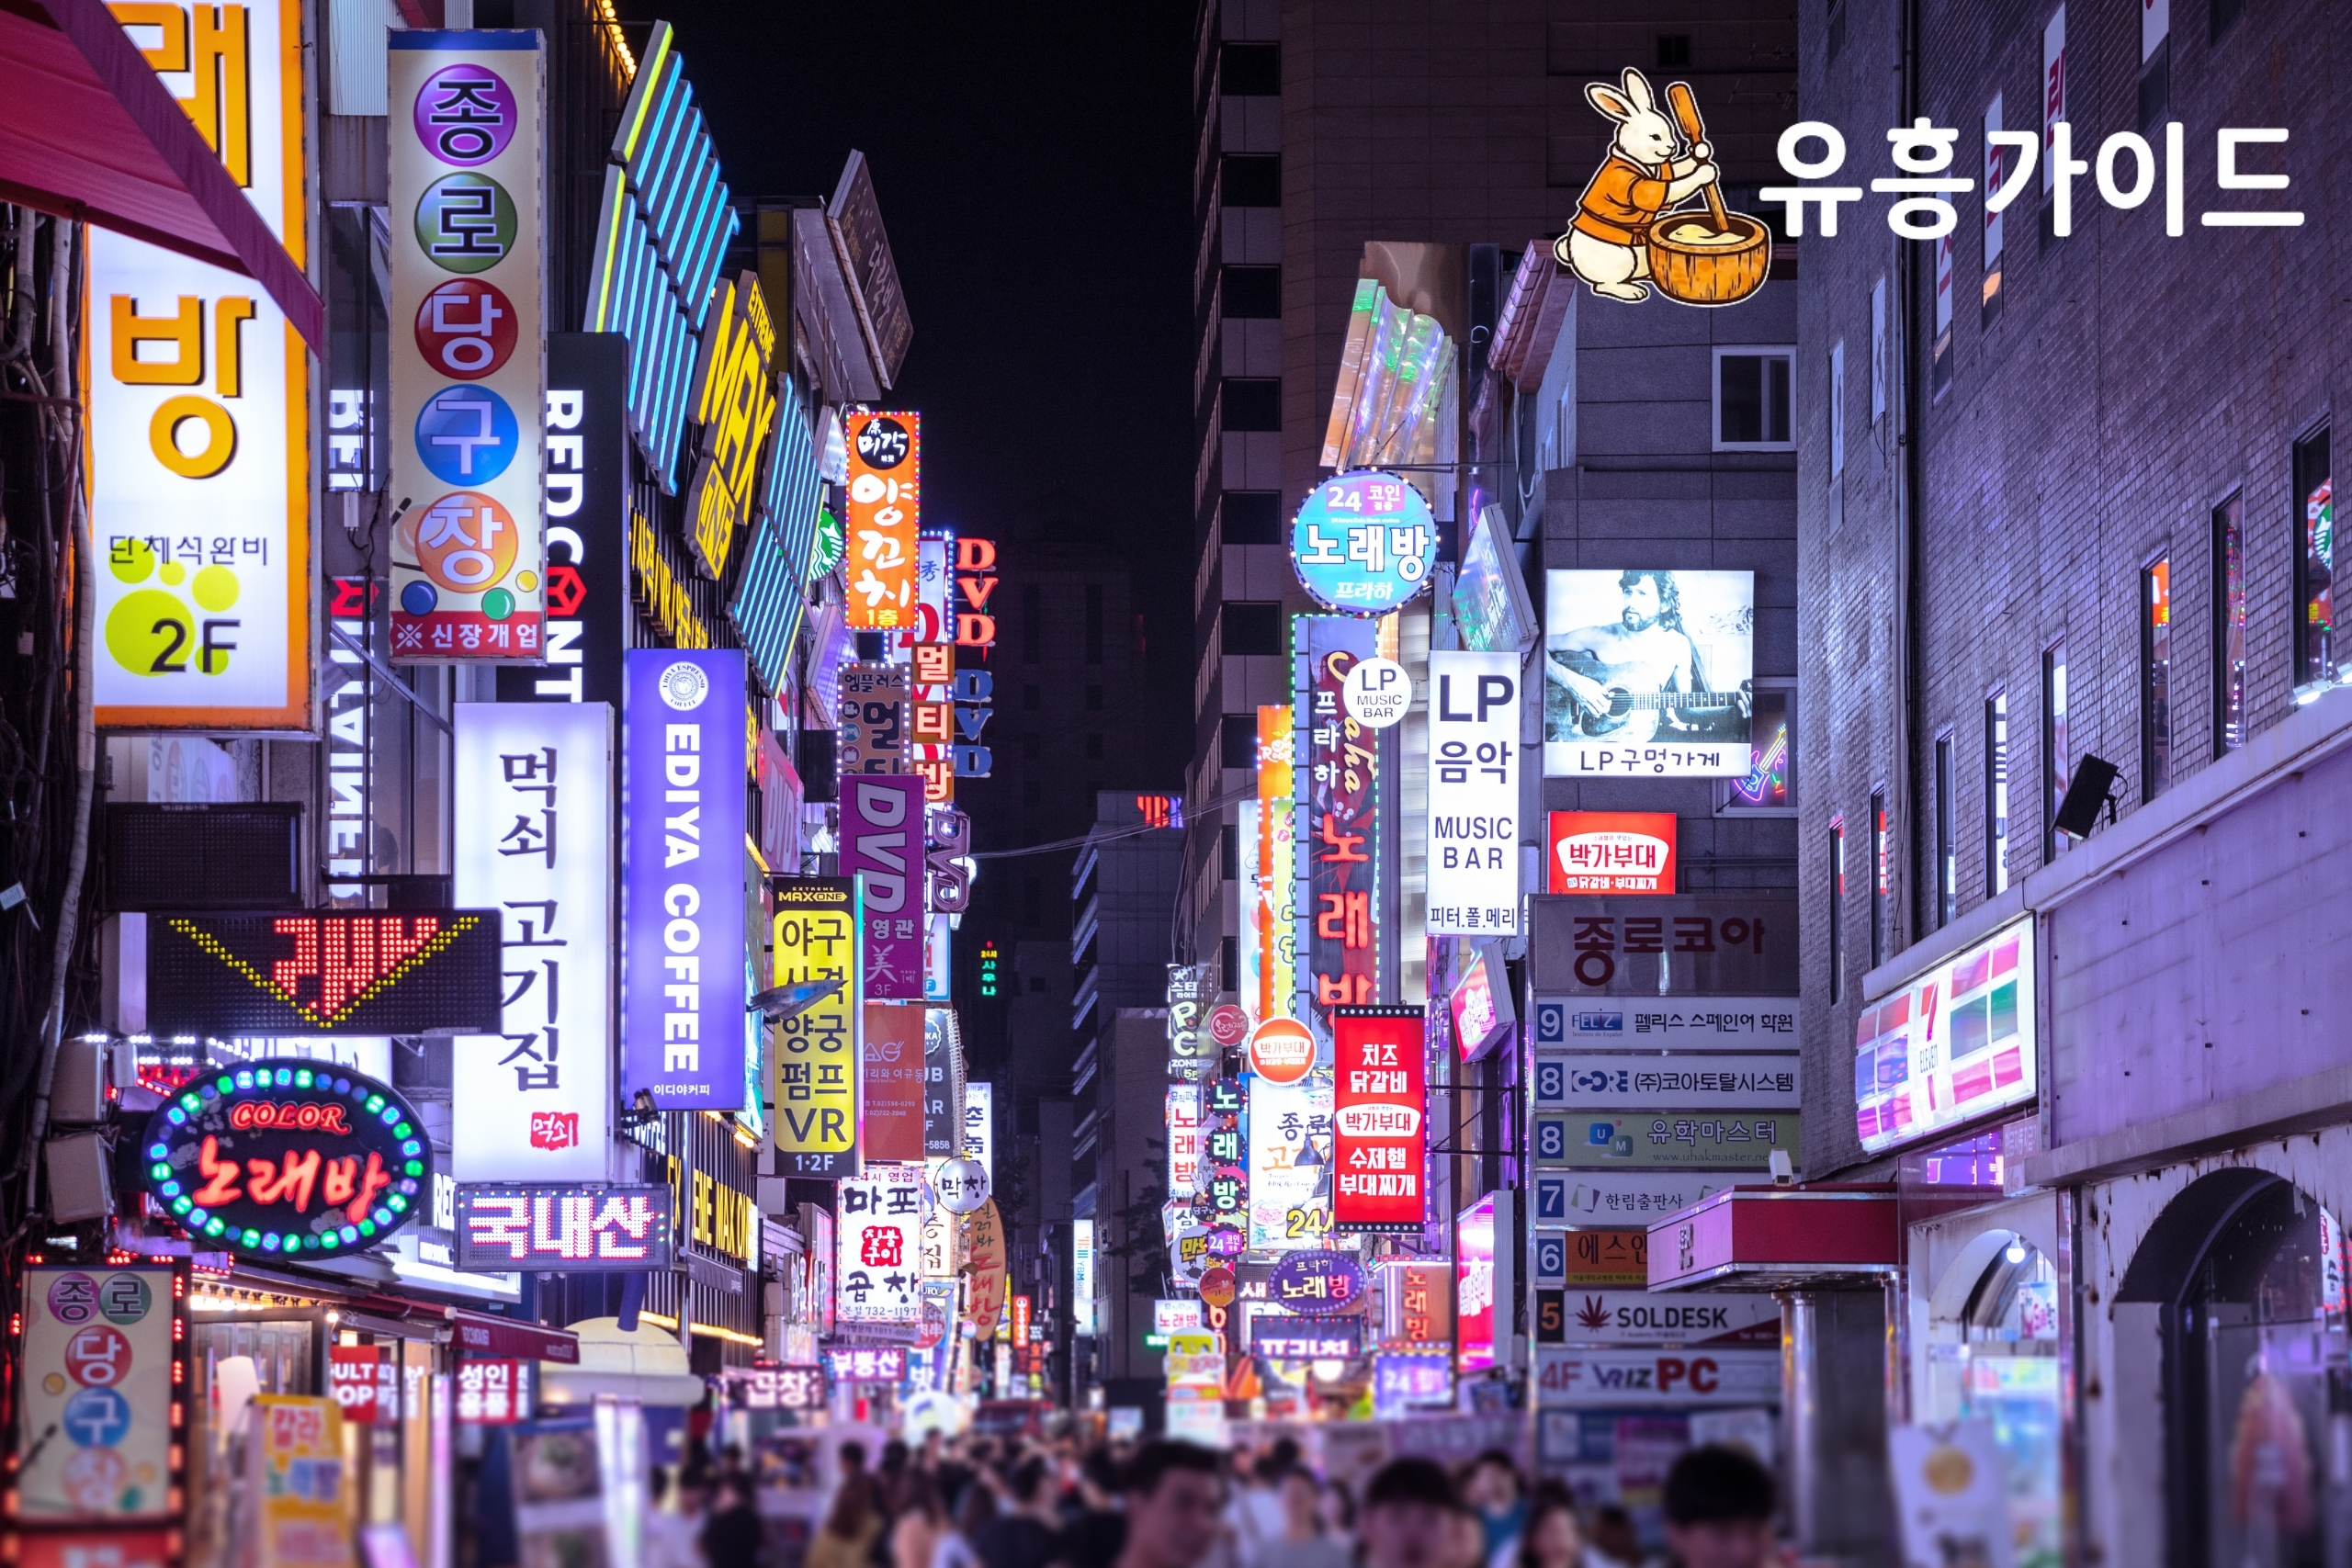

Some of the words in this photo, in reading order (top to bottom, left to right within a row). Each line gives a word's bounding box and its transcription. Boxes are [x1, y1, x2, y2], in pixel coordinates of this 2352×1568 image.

[429, 79, 504, 586] 종로당구장
[748, 279, 775, 365] EXTREME
[699, 279, 777, 525] MAX
[867, 418, 882, 434] 原
[1328, 486, 1363, 512] 24
[1367, 485, 1400, 502] 코인
[109, 535, 268, 566] 단체석완비
[1300, 524, 1430, 582] 노래방
[956, 538, 999, 646] DVD
[1334, 581, 1394, 601] 프라하
[866, 609, 899, 626] 1층
[150, 617, 241, 674] 2F
[430, 623, 538, 649] 신장개업
[843, 673, 904, 693] 엠플러스
[1362, 669, 1396, 691] LP
[1357, 694, 1402, 707] MUSIC
[1363, 707, 1394, 718] BAR
[1439, 674, 1515, 723] LP
[915, 645, 953, 801] 멀티방
[954, 669, 994, 779] DVD
[1314, 690, 1340, 790] 프라하
[1435, 740, 1513, 784] 음악
[1580, 750, 1614, 771] LP
[1621, 749, 1721, 773] 구멍가게
[497, 746, 559, 870] 먹쇠
[664, 723, 701, 869] EDIYA
[1434, 816, 1513, 840] MUSIC
[855, 781, 908, 914] DVD
[1443, 846, 1503, 870] BAR
[1569, 843, 1656, 868] 박가부대
[782, 918, 847, 957] 야구
[864, 919, 916, 941] 영관
[865, 943, 899, 983] 美
[1573, 916, 1766, 987] 종로코아
[663, 884, 701, 1072] COFFEE
[874, 983, 892, 996] 3F
[981, 960, 997, 997] 사우나
[498, 899, 568, 1092] 고기집
[782, 1014, 847, 1054] 양궁
[1171, 1000, 1197, 1056] PC
[1540, 1009, 1561, 1038] 9
[1634, 1013, 1685, 1033] 펠리스
[1690, 1013, 1755, 1033] 스페인어
[1761, 1013, 1794, 1033] 학원
[1261, 1041, 1305, 1055] 박가부대
[1362, 1043, 1398, 1066] 치즈
[1171, 1058, 1198, 1067] ZONE
[653, 1083, 710, 1097] 이디야커피
[781, 1062, 848, 1100] 펌프
[1350, 1070, 1408, 1094] 닭갈비
[1541, 1067, 1561, 1096] 8
[1572, 1070, 1628, 1093] CORE
[1634, 1072, 1794, 1092] (주)코아토탈시스템
[230, 1101, 351, 1134] COLOR
[784, 1108, 848, 1144] VR
[1277, 1111, 1333, 1142] 종로
[1345, 1112, 1411, 1133] 박가부대
[1174, 1108, 1197, 1183] 노래방
[1541, 1125, 1561, 1155] 8
[1647, 1120, 1777, 1146] 유학마스터
[1213, 1085, 1240, 1210] 노래방
[1349, 1147, 1407, 1169] 수제햄
[1653, 1150, 1770, 1162] www.uhakmaster.ne
[194, 1134, 390, 1224] 노래방
[888, 1172, 913, 1182] 영업
[942, 1175, 987, 1200] 막창
[1340, 1174, 1417, 1197] 부대찌개
[843, 1185, 919, 1215] 마포
[1541, 1185, 1561, 1213] 7
[1605, 1193, 1684, 1211] 한림출판사
[469, 1195, 655, 1259] 국내산
[864, 1247, 898, 1265] 구이
[1209, 1235, 1225, 1252] 24
[1226, 1234, 1240, 1246] 코인
[1295, 1258, 1334, 1273] 프라하
[1540, 1244, 1561, 1272] 6
[845, 1270, 918, 1303] 곱창
[1282, 1273, 1351, 1300] 노래방
[56, 1280, 143, 1322] 종로
[865, 1307, 917, 1316] 732-1197
[1159, 1314, 1198, 1327] 노래방
[1541, 1302, 1560, 1330] 5
[1617, 1307, 1728, 1329] SOLDESK
[330, 1363, 375, 1380] ULT
[458, 1364, 509, 1390] 성인
[1539, 1360, 1583, 1393] 4F
[1656, 1357, 1720, 1396] PC
